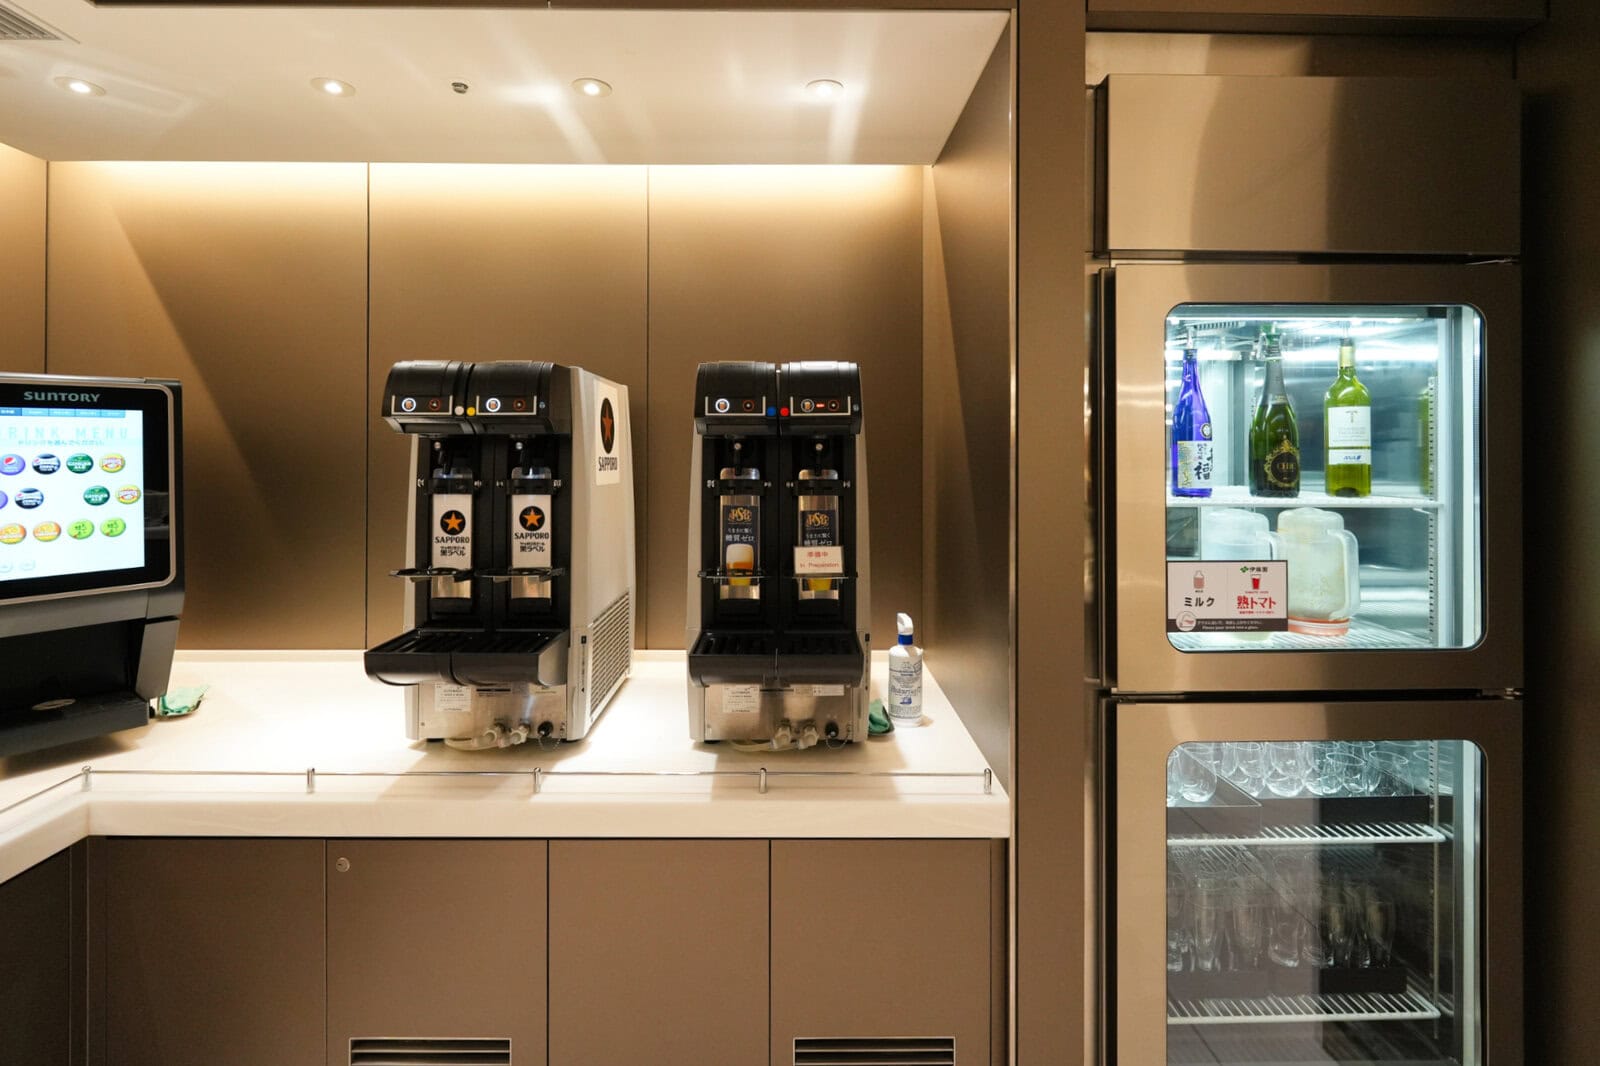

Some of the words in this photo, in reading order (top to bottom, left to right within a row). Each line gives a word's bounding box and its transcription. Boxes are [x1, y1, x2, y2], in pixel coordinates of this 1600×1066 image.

[23, 391, 101, 402] SUNTORY
[0, 426, 60, 440] RINK
[598, 456, 618, 471] SAPPORO
[435, 536, 470, 544] SAPPORO
[514, 532, 550, 540] SAPPORO
[1184, 596, 1215, 607] ミルク
